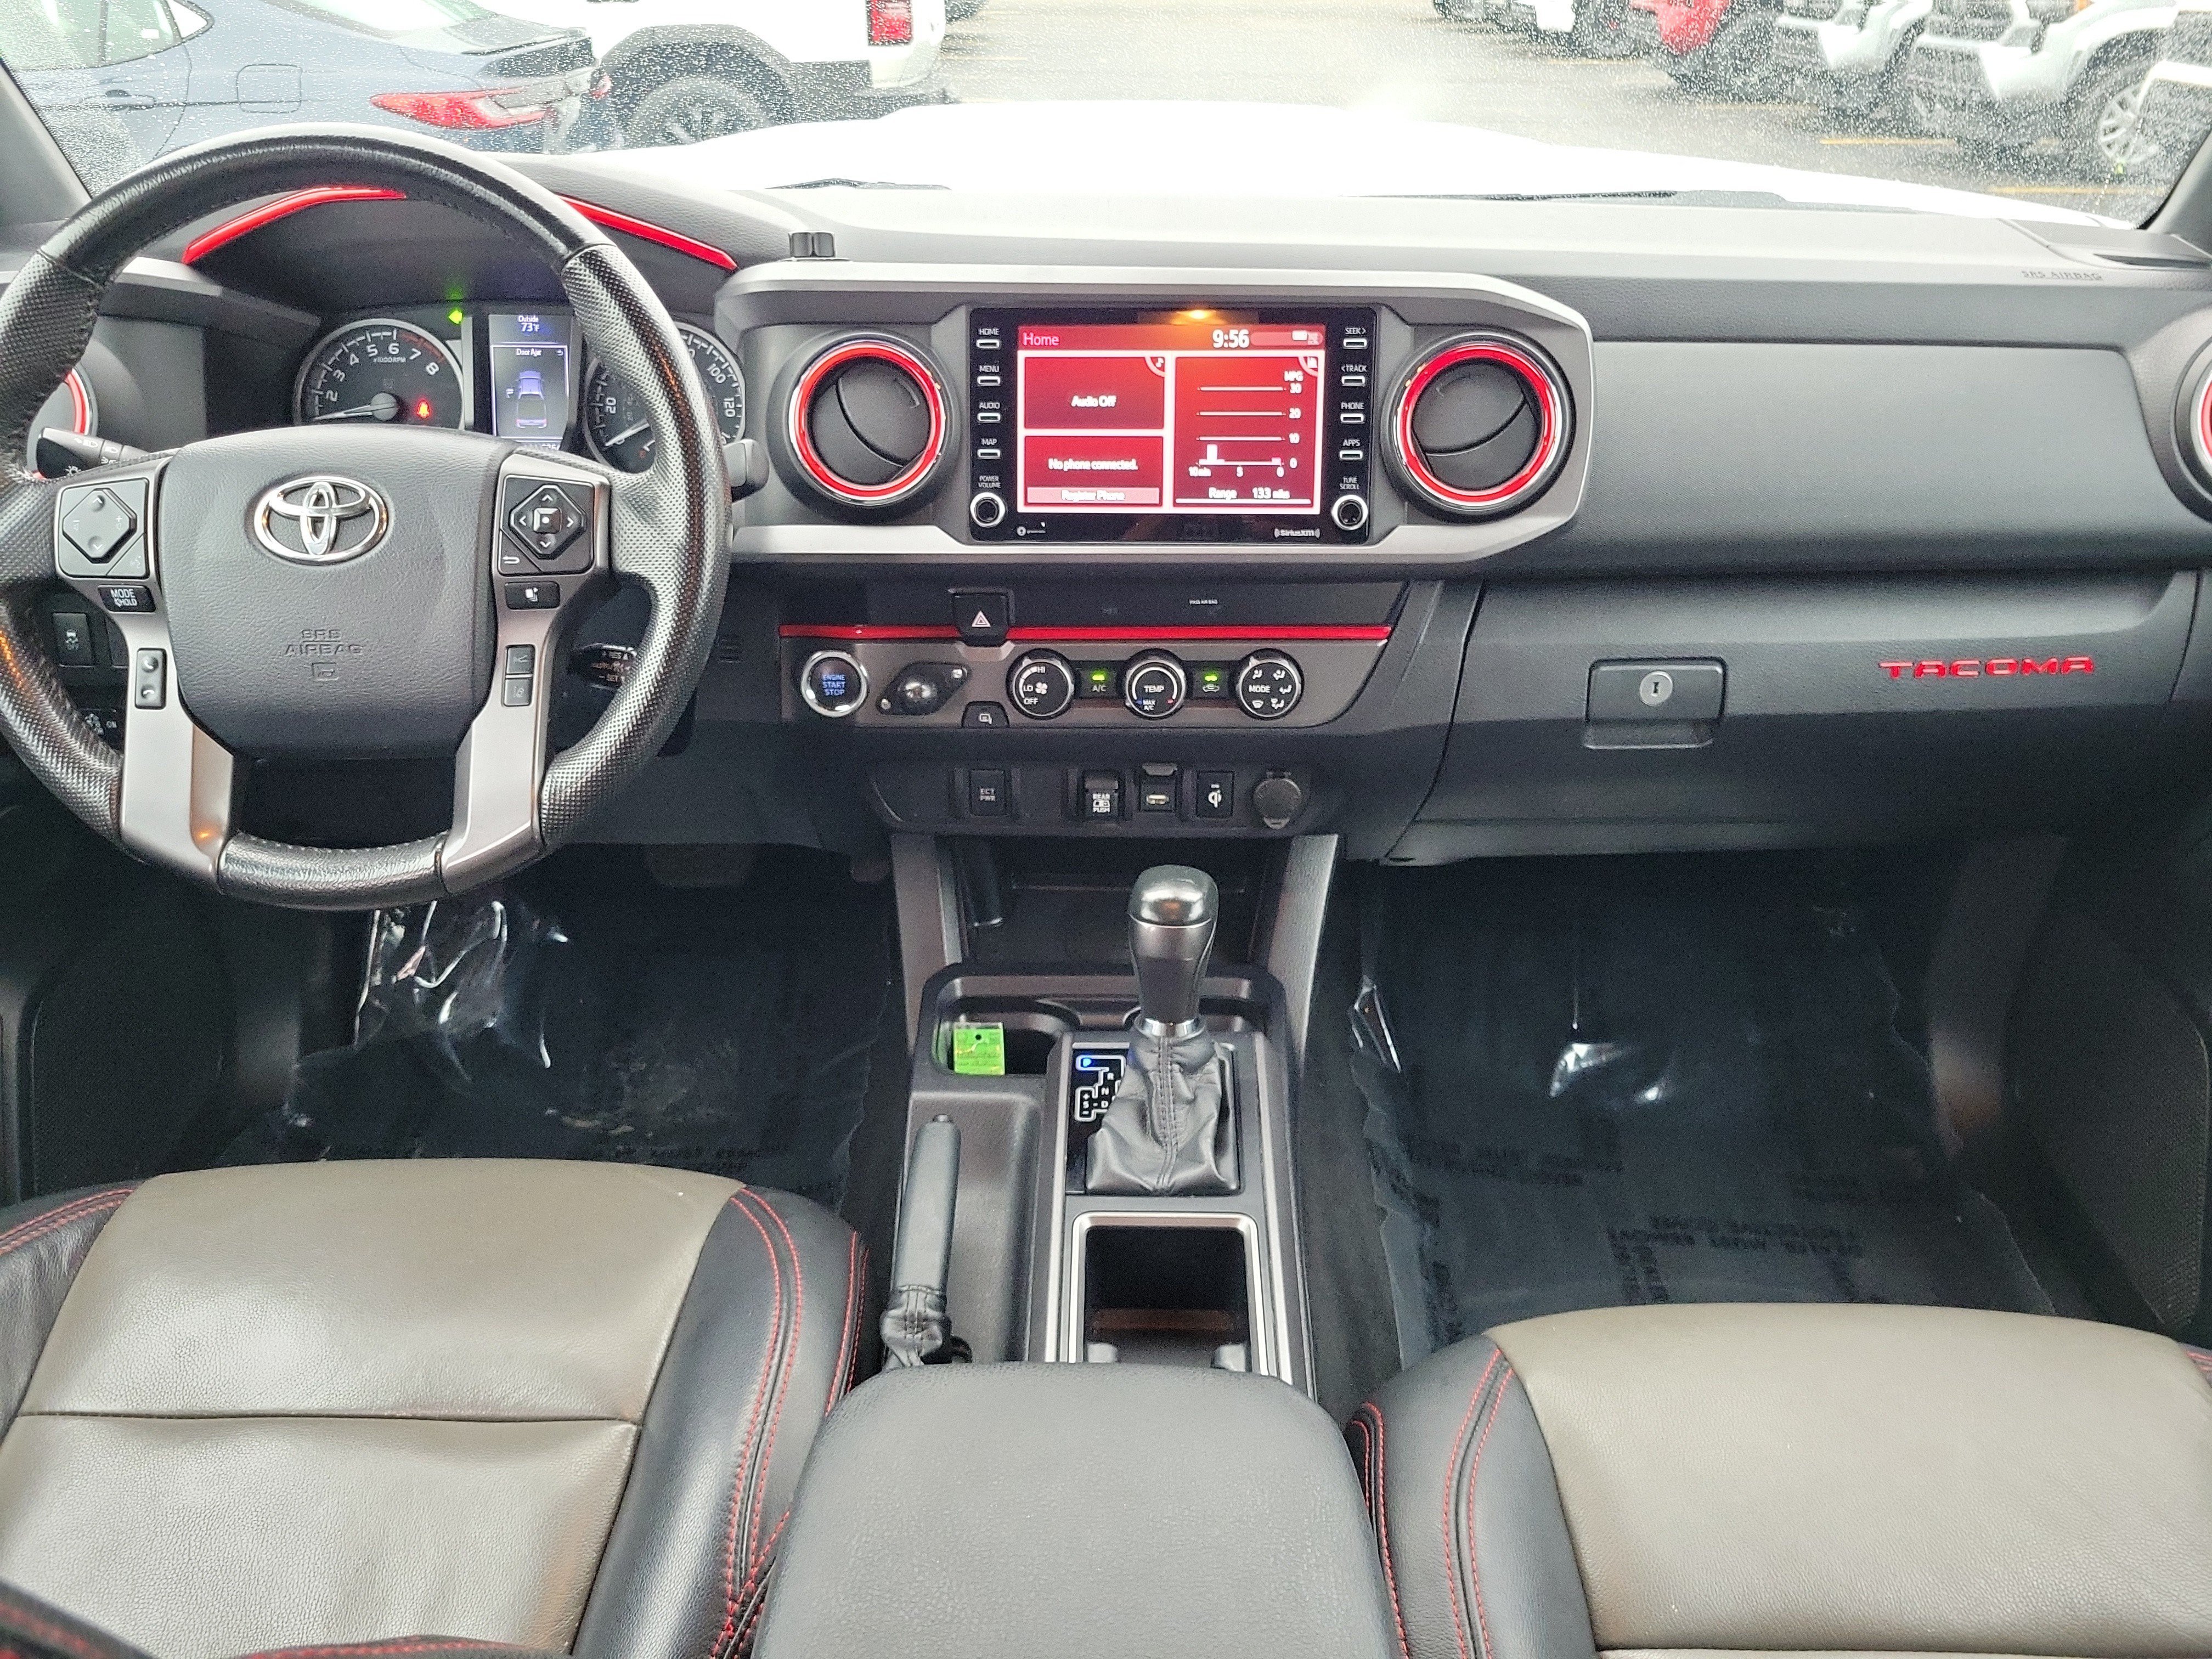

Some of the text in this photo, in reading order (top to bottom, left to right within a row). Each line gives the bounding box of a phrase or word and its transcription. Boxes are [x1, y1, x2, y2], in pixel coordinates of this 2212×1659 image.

[2051, 272, 2103, 280] AIRBAG
[1023, 332, 1059, 346] Home
[1212, 329, 1250, 348] 9:56
[366, 343, 379, 357] 5
[388, 343, 400, 355] 6
[410, 348, 421, 360] 7
[531, 348, 541, 357] Ajar
[349, 353, 360, 365] 4
[425, 362, 439, 375] 8
[707, 364, 726, 383] 100
[333, 369, 346, 382] 3
[1284, 370, 1304, 382] MPG
[1290, 383, 1302, 394] 30
[326, 390, 338, 402] 2
[1071, 395, 1117, 407] Audio Off
[606, 397, 616, 414] 20
[724, 397, 736, 417] 120
[1341, 402, 1364, 410] PHONE
[1289, 408, 1301, 419] 20
[1289, 433, 1300, 444] 10
[1048, 458, 1063, 470] No
[1063, 458, 1091, 472] phone
[1290, 458, 1297, 469] 0
[1276, 466, 1284, 477] 0
[1097, 489, 1125, 501] Phone
[1209, 487, 1237, 500] Range
[1252, 487, 1271, 499] 133
[110, 589, 136, 599] MODE
[119, 597, 137, 606] HOLD
[284, 644, 367, 657] AIRBAG
[1037, 665, 1046, 674] HI
[1878, 656, 2094, 679] TACOMA
[1249, 685, 1271, 693] MODE
[1101, 1087, 1109, 1096] N
[1082, 1101, 1090, 1109] S
